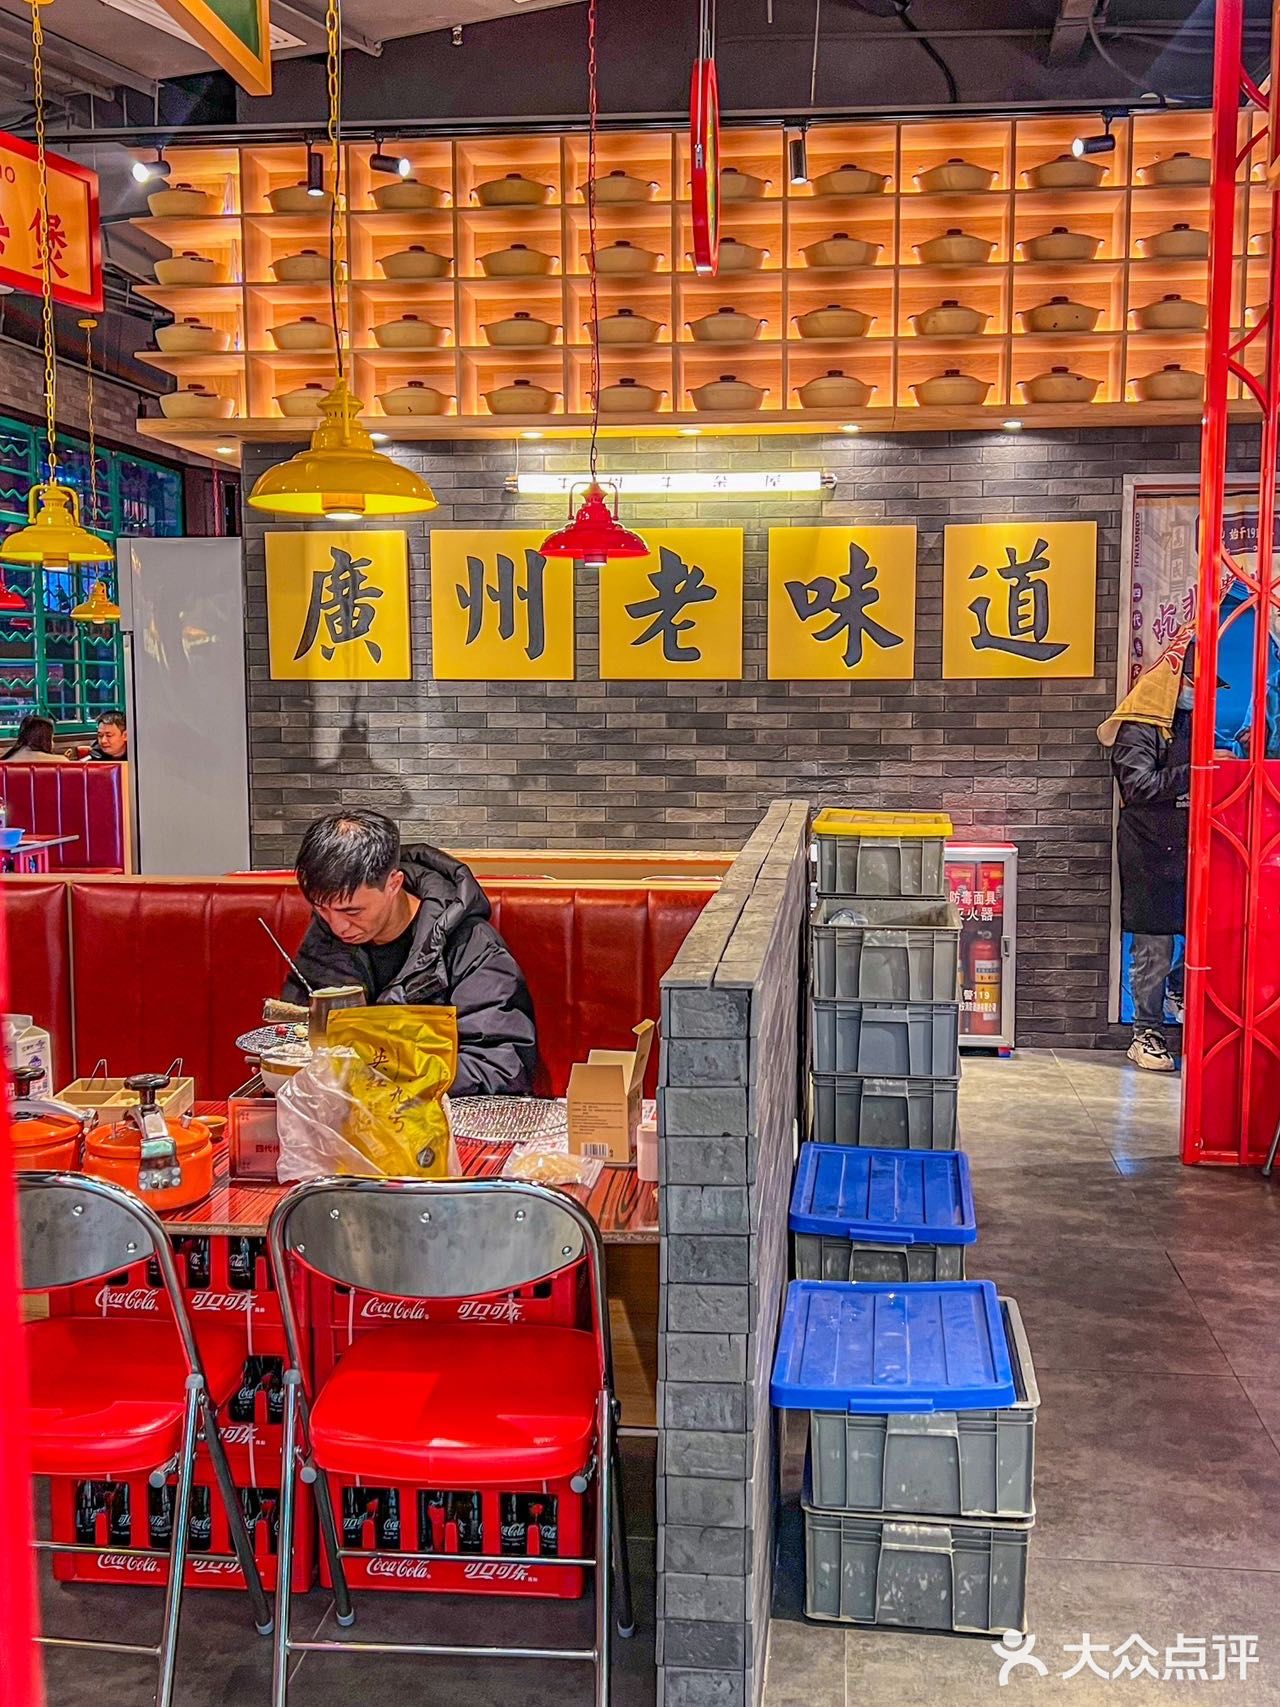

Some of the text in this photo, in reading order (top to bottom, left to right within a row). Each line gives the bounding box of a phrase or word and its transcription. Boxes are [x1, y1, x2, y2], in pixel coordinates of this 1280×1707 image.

[292, 537, 1071, 668] 廣州老味道
[950, 890, 997, 905] 防毒面具
[191, 1291, 258, 1311] 可口可乐
[360, 1296, 426, 1320] Coca-Cola
[457, 1300, 524, 1320] 可口可乐
[366, 1557, 428, 1579] Coca-Cola
[464, 1562, 531, 1581] 可口可乐
